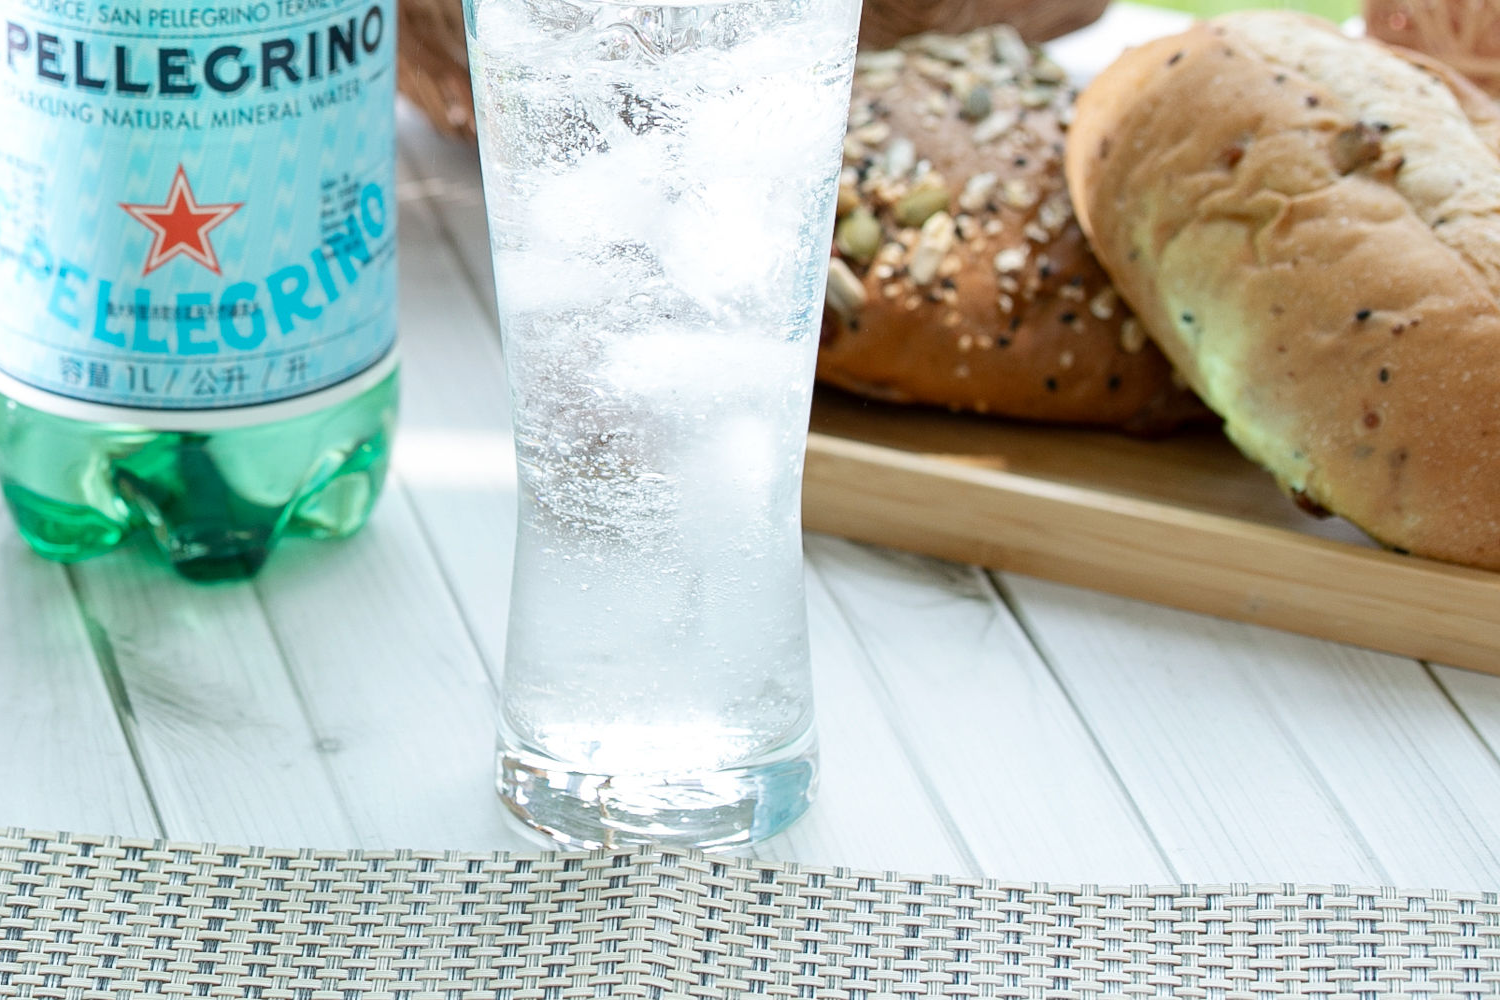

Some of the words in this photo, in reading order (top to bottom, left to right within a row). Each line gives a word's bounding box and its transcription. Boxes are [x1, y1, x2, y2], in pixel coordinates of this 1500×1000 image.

[97, 4, 141, 26] SAN
[147, 2, 270, 30] PELLEGRINO
[102, 108, 202, 131] NATURAL
[210, 99, 302, 130] MINERAL
[308, 78, 361, 112] WATER
